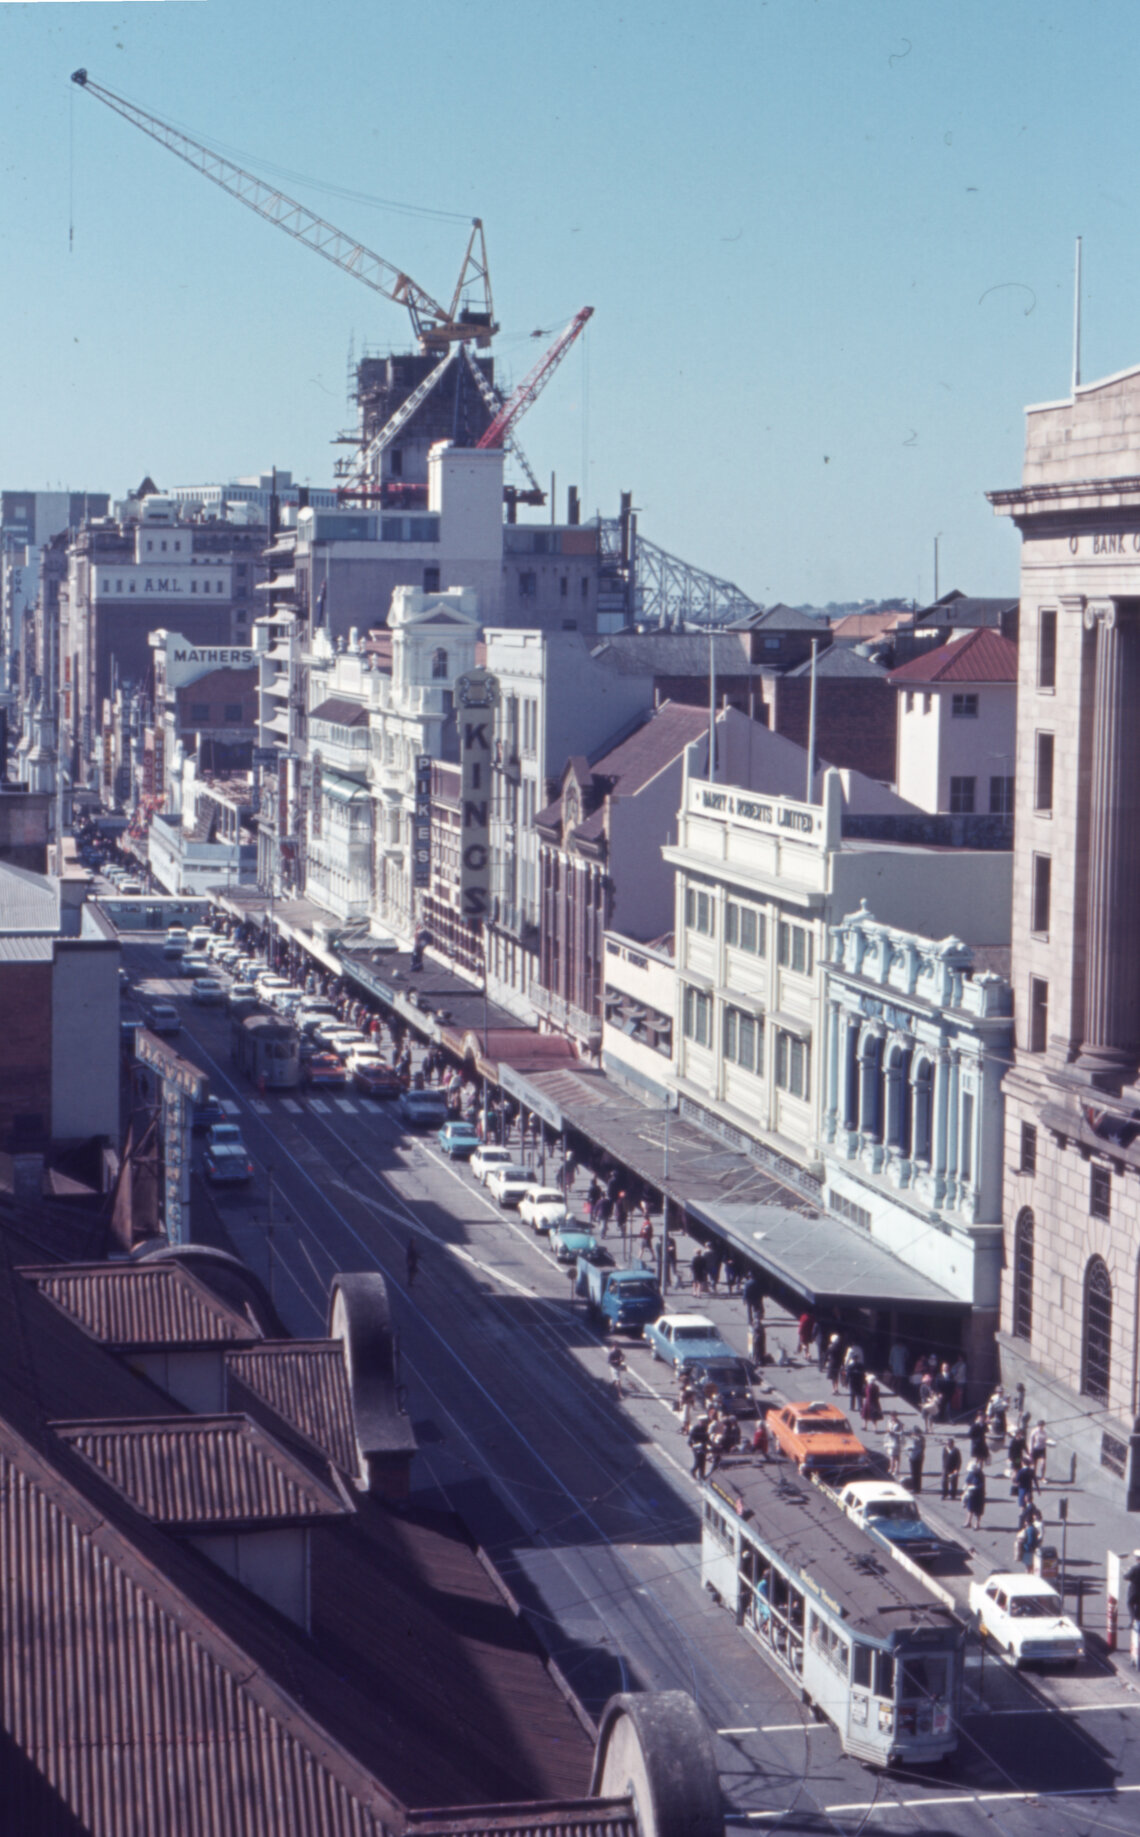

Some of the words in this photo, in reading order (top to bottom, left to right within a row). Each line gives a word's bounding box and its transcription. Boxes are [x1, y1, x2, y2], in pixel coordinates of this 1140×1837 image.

[1093, 534, 1127, 554] BANK
[175, 649, 253, 663] MATHERS
[418, 758, 430, 862] PIKES
[464, 723, 490, 914] KINGS
[778, 806, 814, 834] LIMITED
